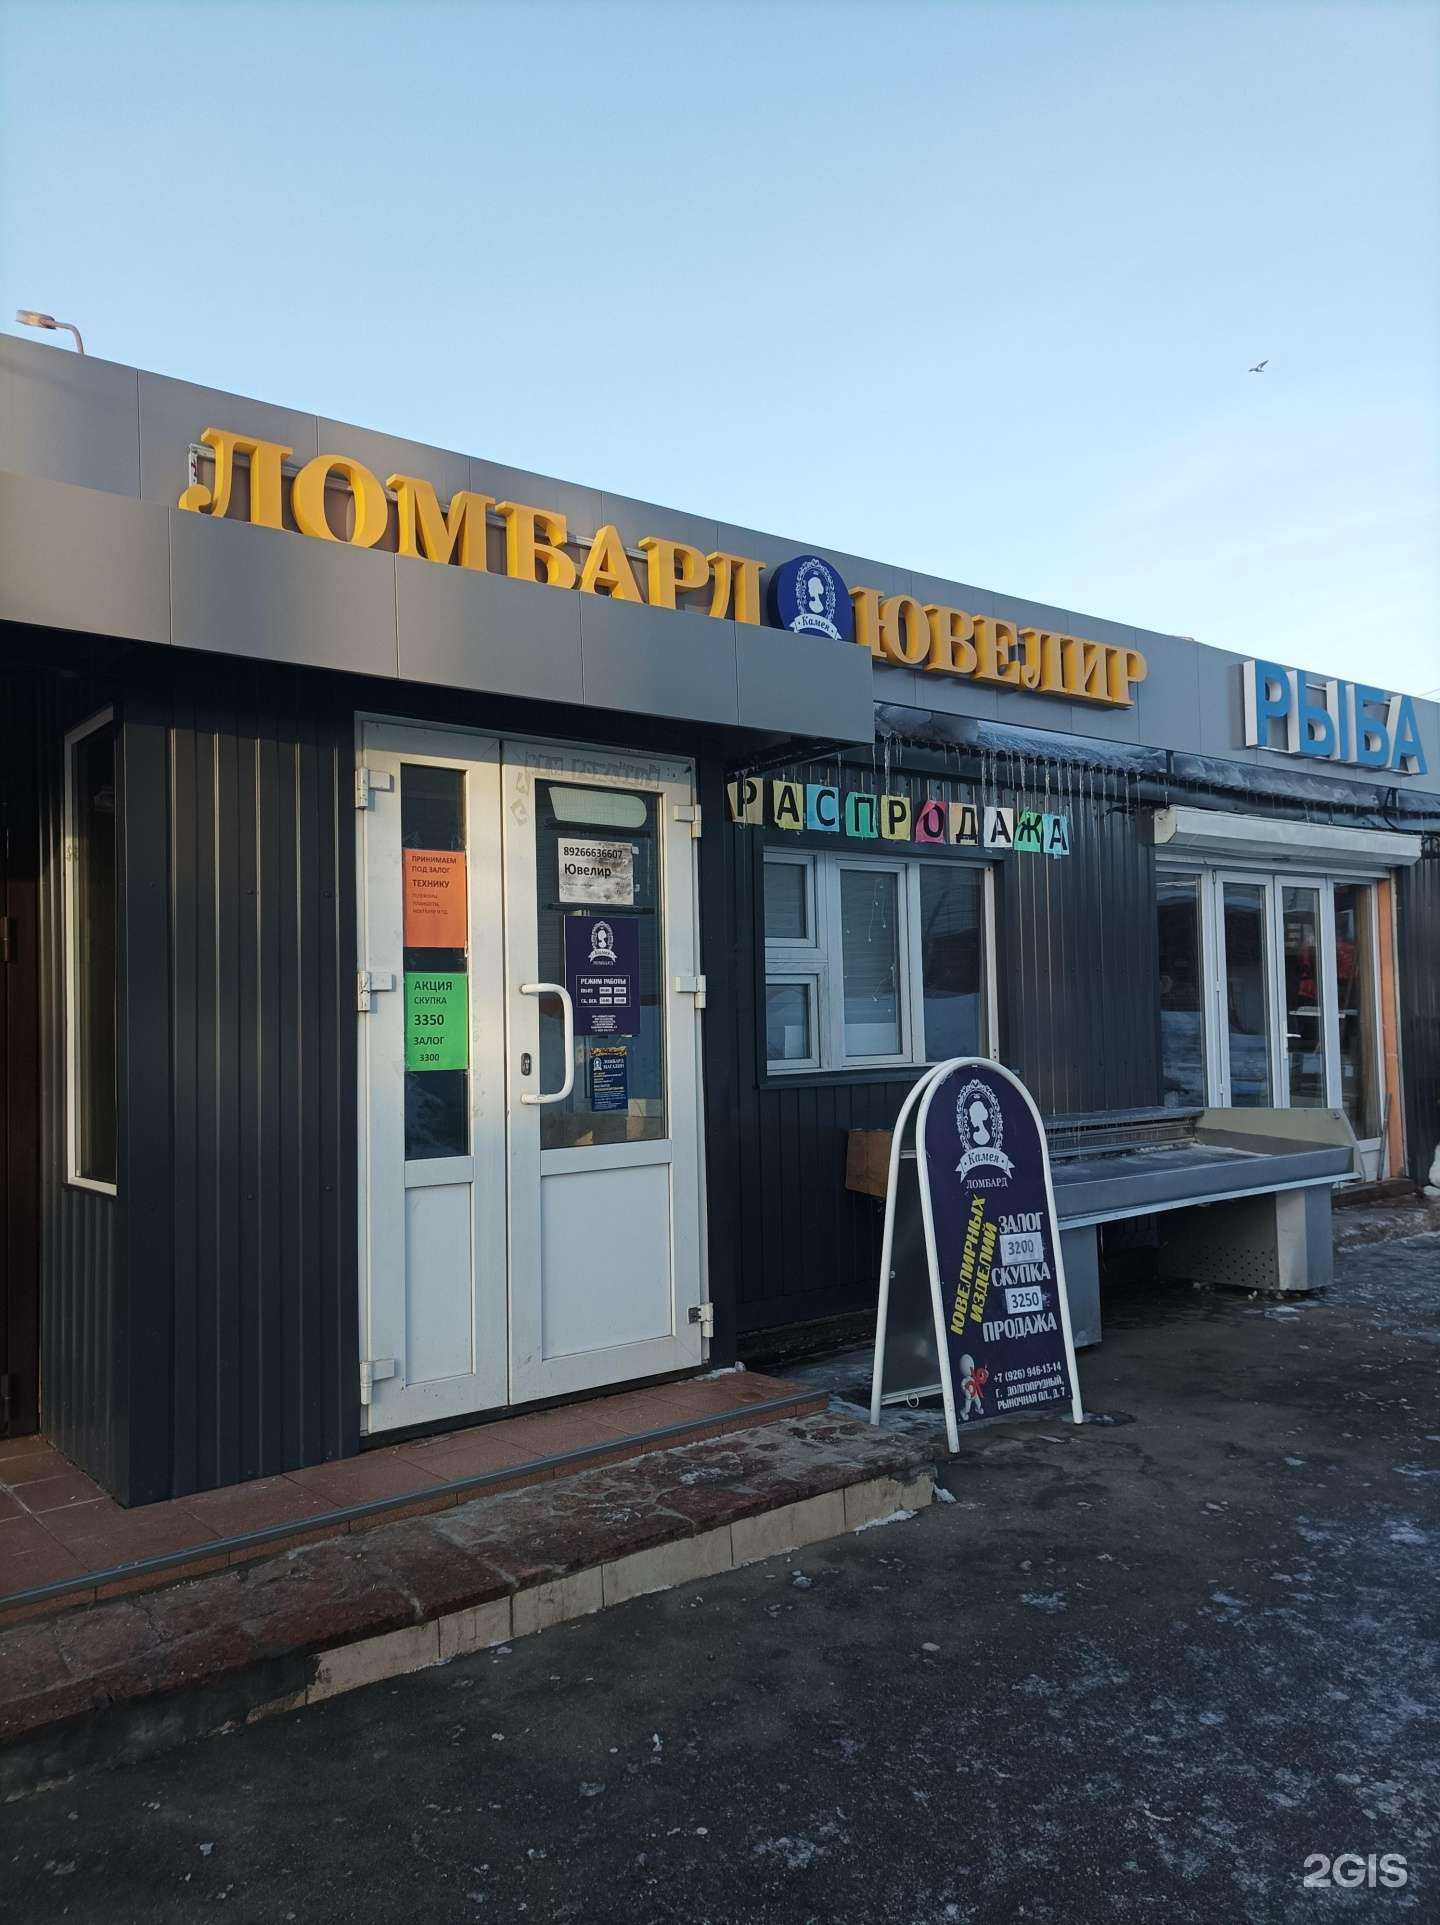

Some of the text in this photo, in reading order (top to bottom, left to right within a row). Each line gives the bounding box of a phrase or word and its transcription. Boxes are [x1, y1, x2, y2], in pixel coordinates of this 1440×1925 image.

[802, 616, 830, 632] Камея
[848, 585, 1148, 709] ЮВЕЛИР
[1243, 659, 1428, 776] РЫБА
[736, 777, 1068, 852] РАСПРОДАЖА
[411, 855, 457, 865] ПРИНИМАЕМ
[563, 846, 623, 859] 89266636607
[564, 863, 612, 879] Ювелир
[412, 879, 450, 889] ТЕХНИКУ
[414, 980, 453, 993] АКЦИЯ
[414, 996, 448, 1005] СКУПКА
[414, 1014, 445, 1026] 3350
[413, 1036, 446, 1046] ЗАЛОГ
[419, 1052, 440, 1062] 3300
[968, 1152, 1000, 1166] Камея
[966, 1178, 1009, 1189] ЛОМБАРД
[998, 1212, 1044, 1235] ЗАЛОГ
[1007, 1240, 1034, 1256] 3200
[950, 1193, 986, 1336] ЮВЕЛИРНЫХ
[970, 1222, 998, 1323] ИЗДЕЛИЙ
[991, 1262, 1052, 1287] СКУПКА
[1011, 1291, 1039, 1309] 3250
[982, 1312, 1058, 1343] ПРОДАЖА
[993, 1372, 1003, 1383] +7
[1005, 1368, 1026, 1382] (926)
[997, 1393, 1038, 1411] РЫНОЧНАЯ
